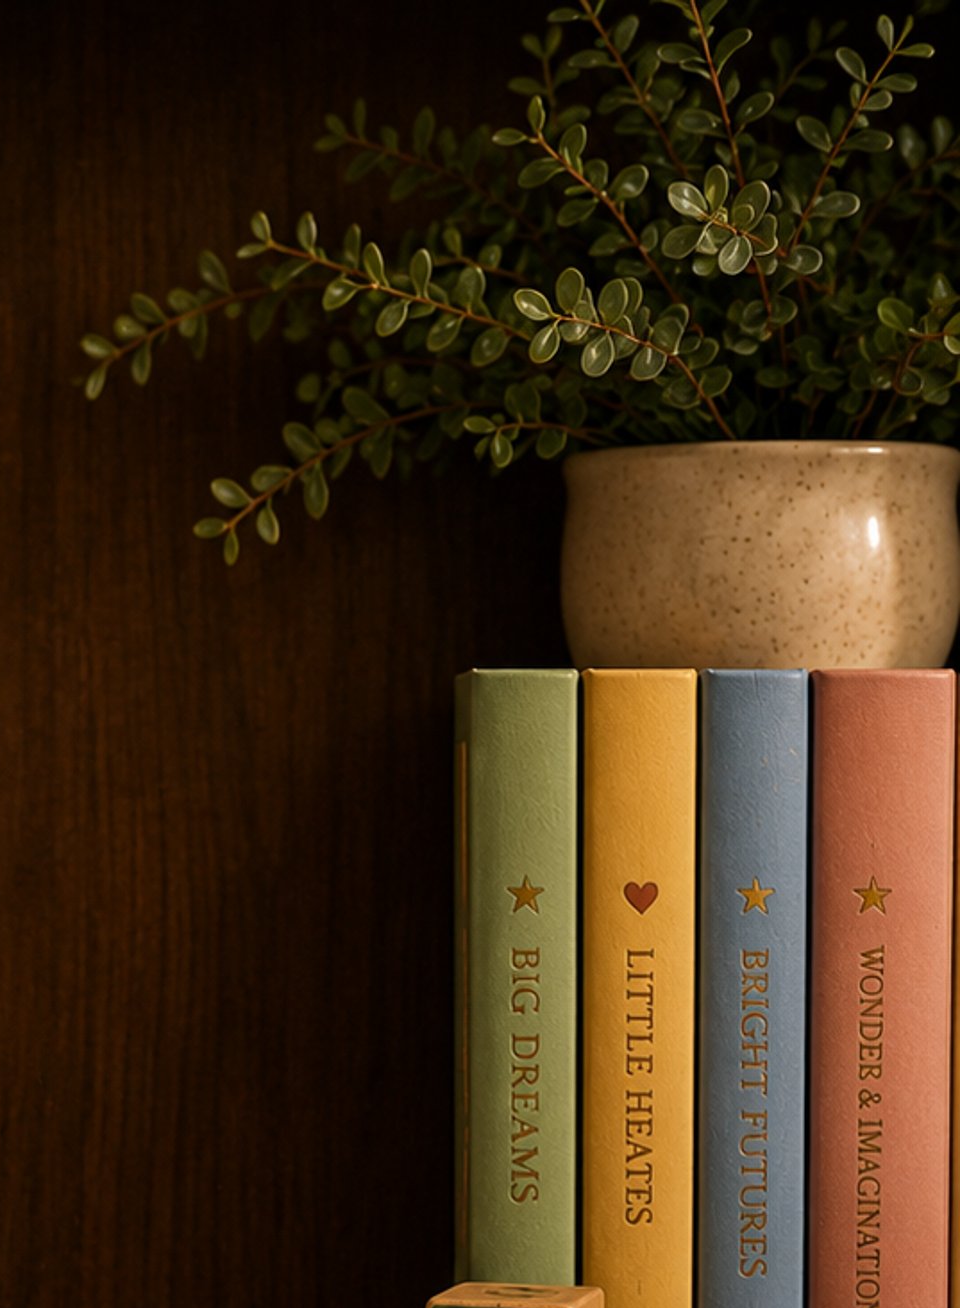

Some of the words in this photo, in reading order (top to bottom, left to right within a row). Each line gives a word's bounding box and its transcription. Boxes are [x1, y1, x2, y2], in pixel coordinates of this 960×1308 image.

[510, 947, 540, 1014] BIG
[624, 948, 655, 1075] LITTLE
[741, 948, 770, 1094] BRIGHT
[510, 1032, 540, 1204] DREAMS
[624, 1090, 654, 1226] HEATES
[857, 1088, 882, 1109] &
[740, 1110, 769, 1278] FUTURES
